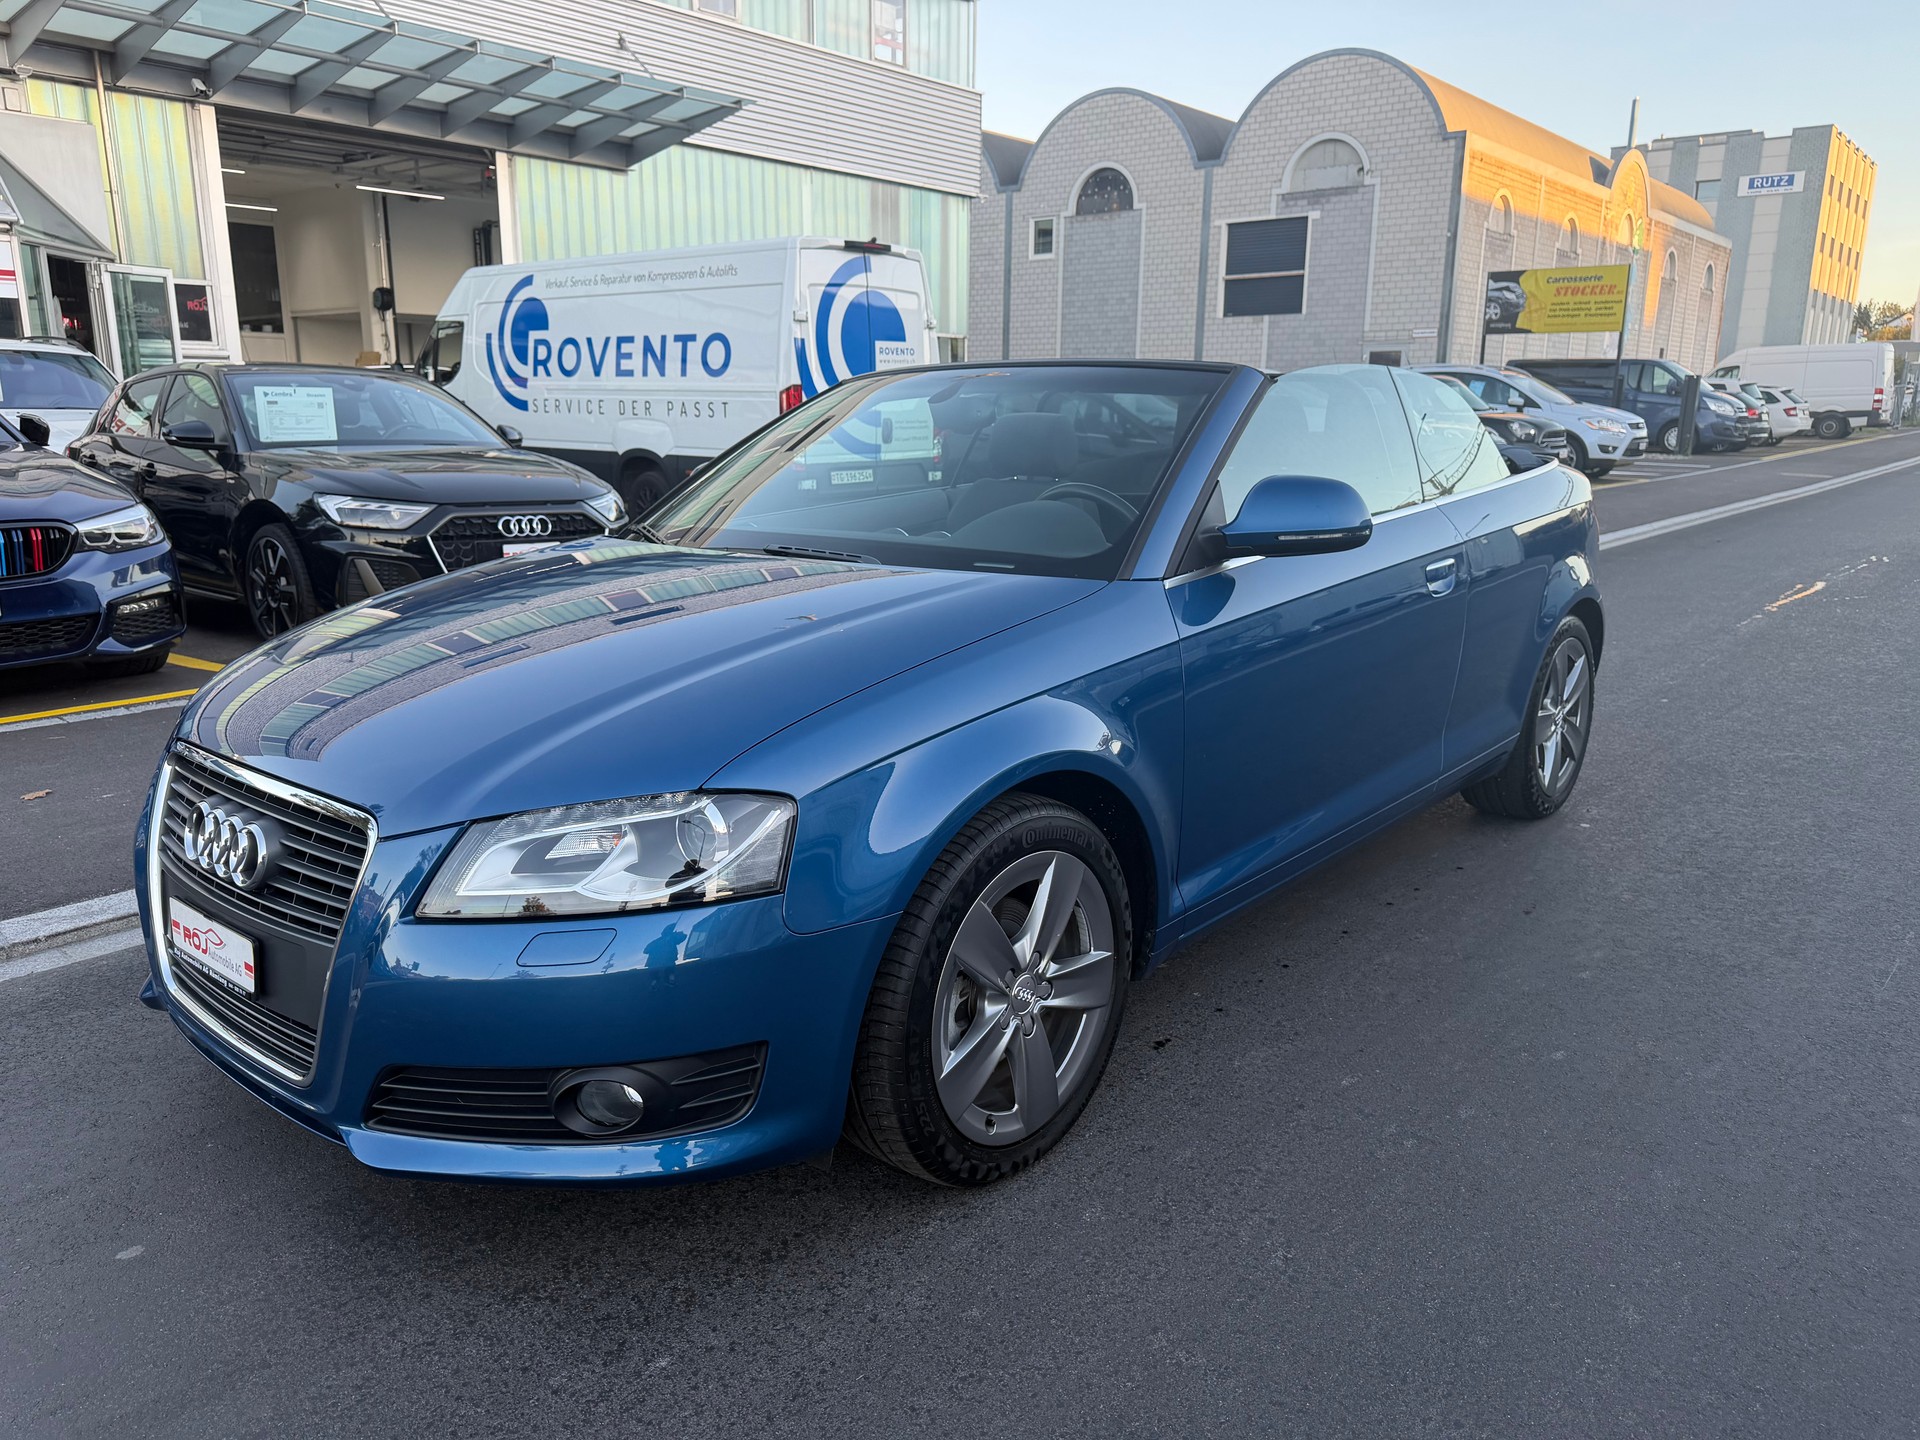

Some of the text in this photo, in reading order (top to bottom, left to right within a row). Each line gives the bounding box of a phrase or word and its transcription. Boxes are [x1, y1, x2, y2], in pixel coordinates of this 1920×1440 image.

[1754, 175, 1789, 188] RUTZ
[570, 275, 592, 288] Service
[600, 273, 632, 288] Reparatur
[633, 275, 646, 283] von
[647, 270, 698, 284] Kompressoren
[700, 265, 705, 279] &
[706, 263, 738, 278] Autolifts
[1546, 274, 1603, 284] Carrosserie
[1554, 284, 1617, 297] STOCKER
[532, 332, 732, 378] ROVENTO
[879, 346, 915, 356] ROVENTO
[532, 398, 729, 419] SERVICE DER PASST
[835, 472, 845, 482] TG
[1022, 825, 1088, 849] Continental
[182, 924, 208, 955] ROJ
[181, 951, 203, 970] Automobile
[208, 946, 242, 977] Automobile AG
